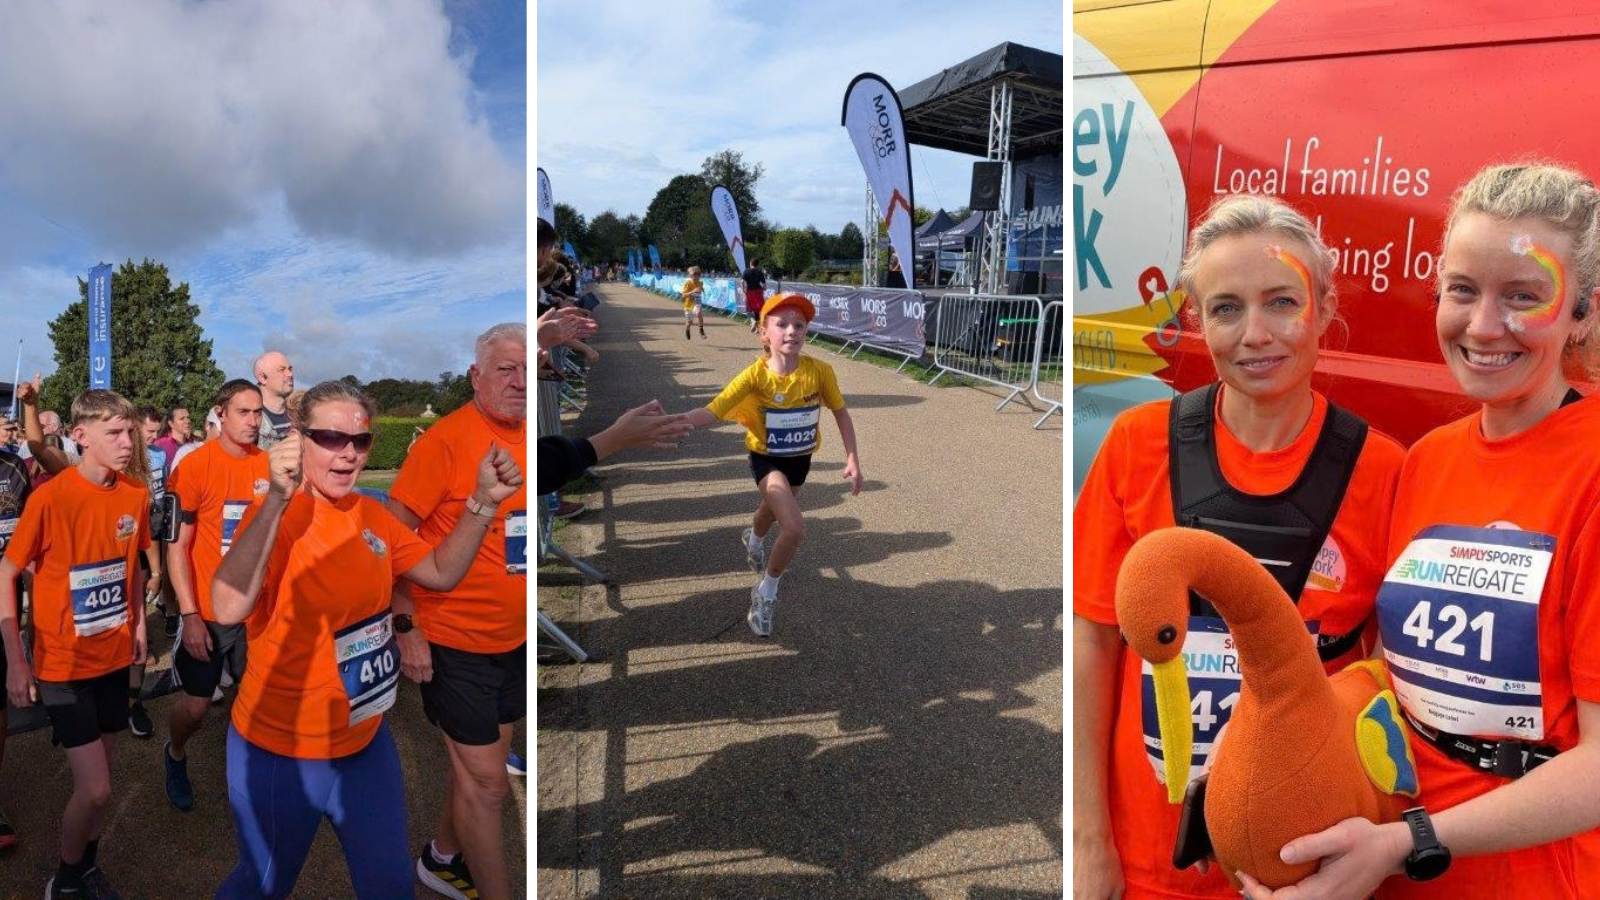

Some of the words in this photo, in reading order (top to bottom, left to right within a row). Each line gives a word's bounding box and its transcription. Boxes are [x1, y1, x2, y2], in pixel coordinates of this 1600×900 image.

[873, 94, 896, 155] MORR
[1214, 137, 1291, 194] Local
[1300, 136, 1430, 197] families
[860, 297, 887, 315] MORR
[767, 428, 817, 444] A-4029
[85, 585, 122, 609] 402
[1402, 600, 1496, 662] 421
[361, 649, 394, 684] 410
[1505, 716, 1535, 729] 421
